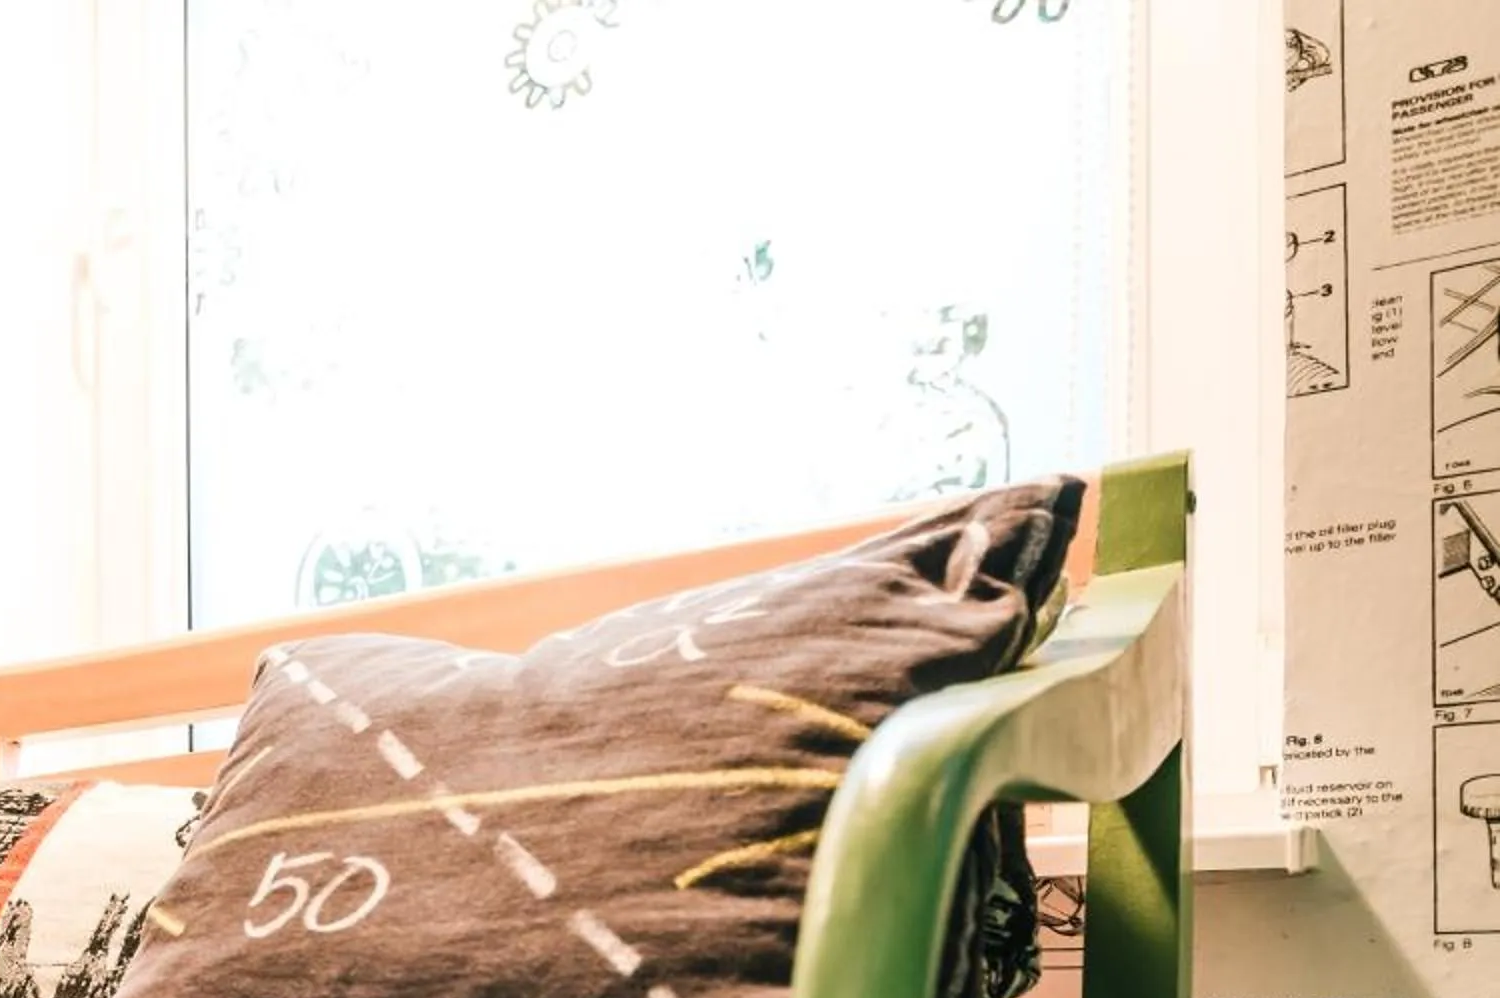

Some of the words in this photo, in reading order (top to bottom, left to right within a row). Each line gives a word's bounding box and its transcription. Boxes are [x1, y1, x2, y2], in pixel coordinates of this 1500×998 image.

[1392, 85, 1466, 108] PROVISION
[1469, 76, 1495, 90] FOR
[1392, 93, 1473, 119] PASSENGER
[1323, 230, 1336, 244] 2
[1320, 283, 1333, 298] 3
[1375, 781, 1394, 790] on
[243, 850, 391, 940] 50
